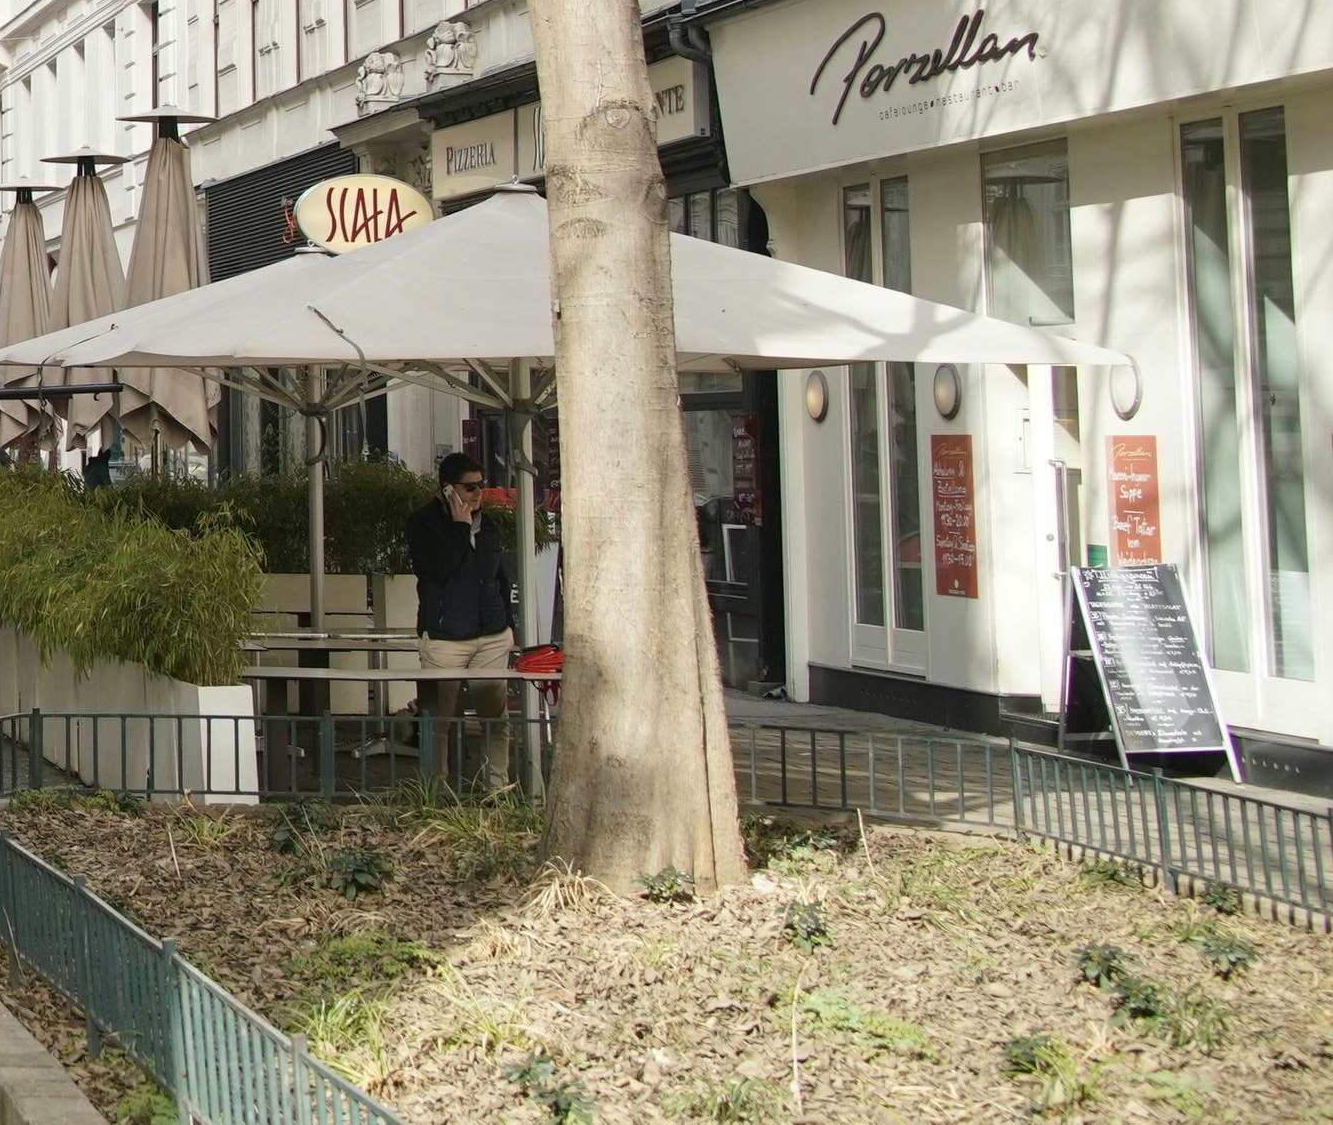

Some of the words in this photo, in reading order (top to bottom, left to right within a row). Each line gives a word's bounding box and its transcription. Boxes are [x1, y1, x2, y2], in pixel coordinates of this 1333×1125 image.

[809, 9, 1040, 125] Porzellan
[446, 141, 497, 176] PIZZERIA
[325, 187, 418, 243] SCALA
